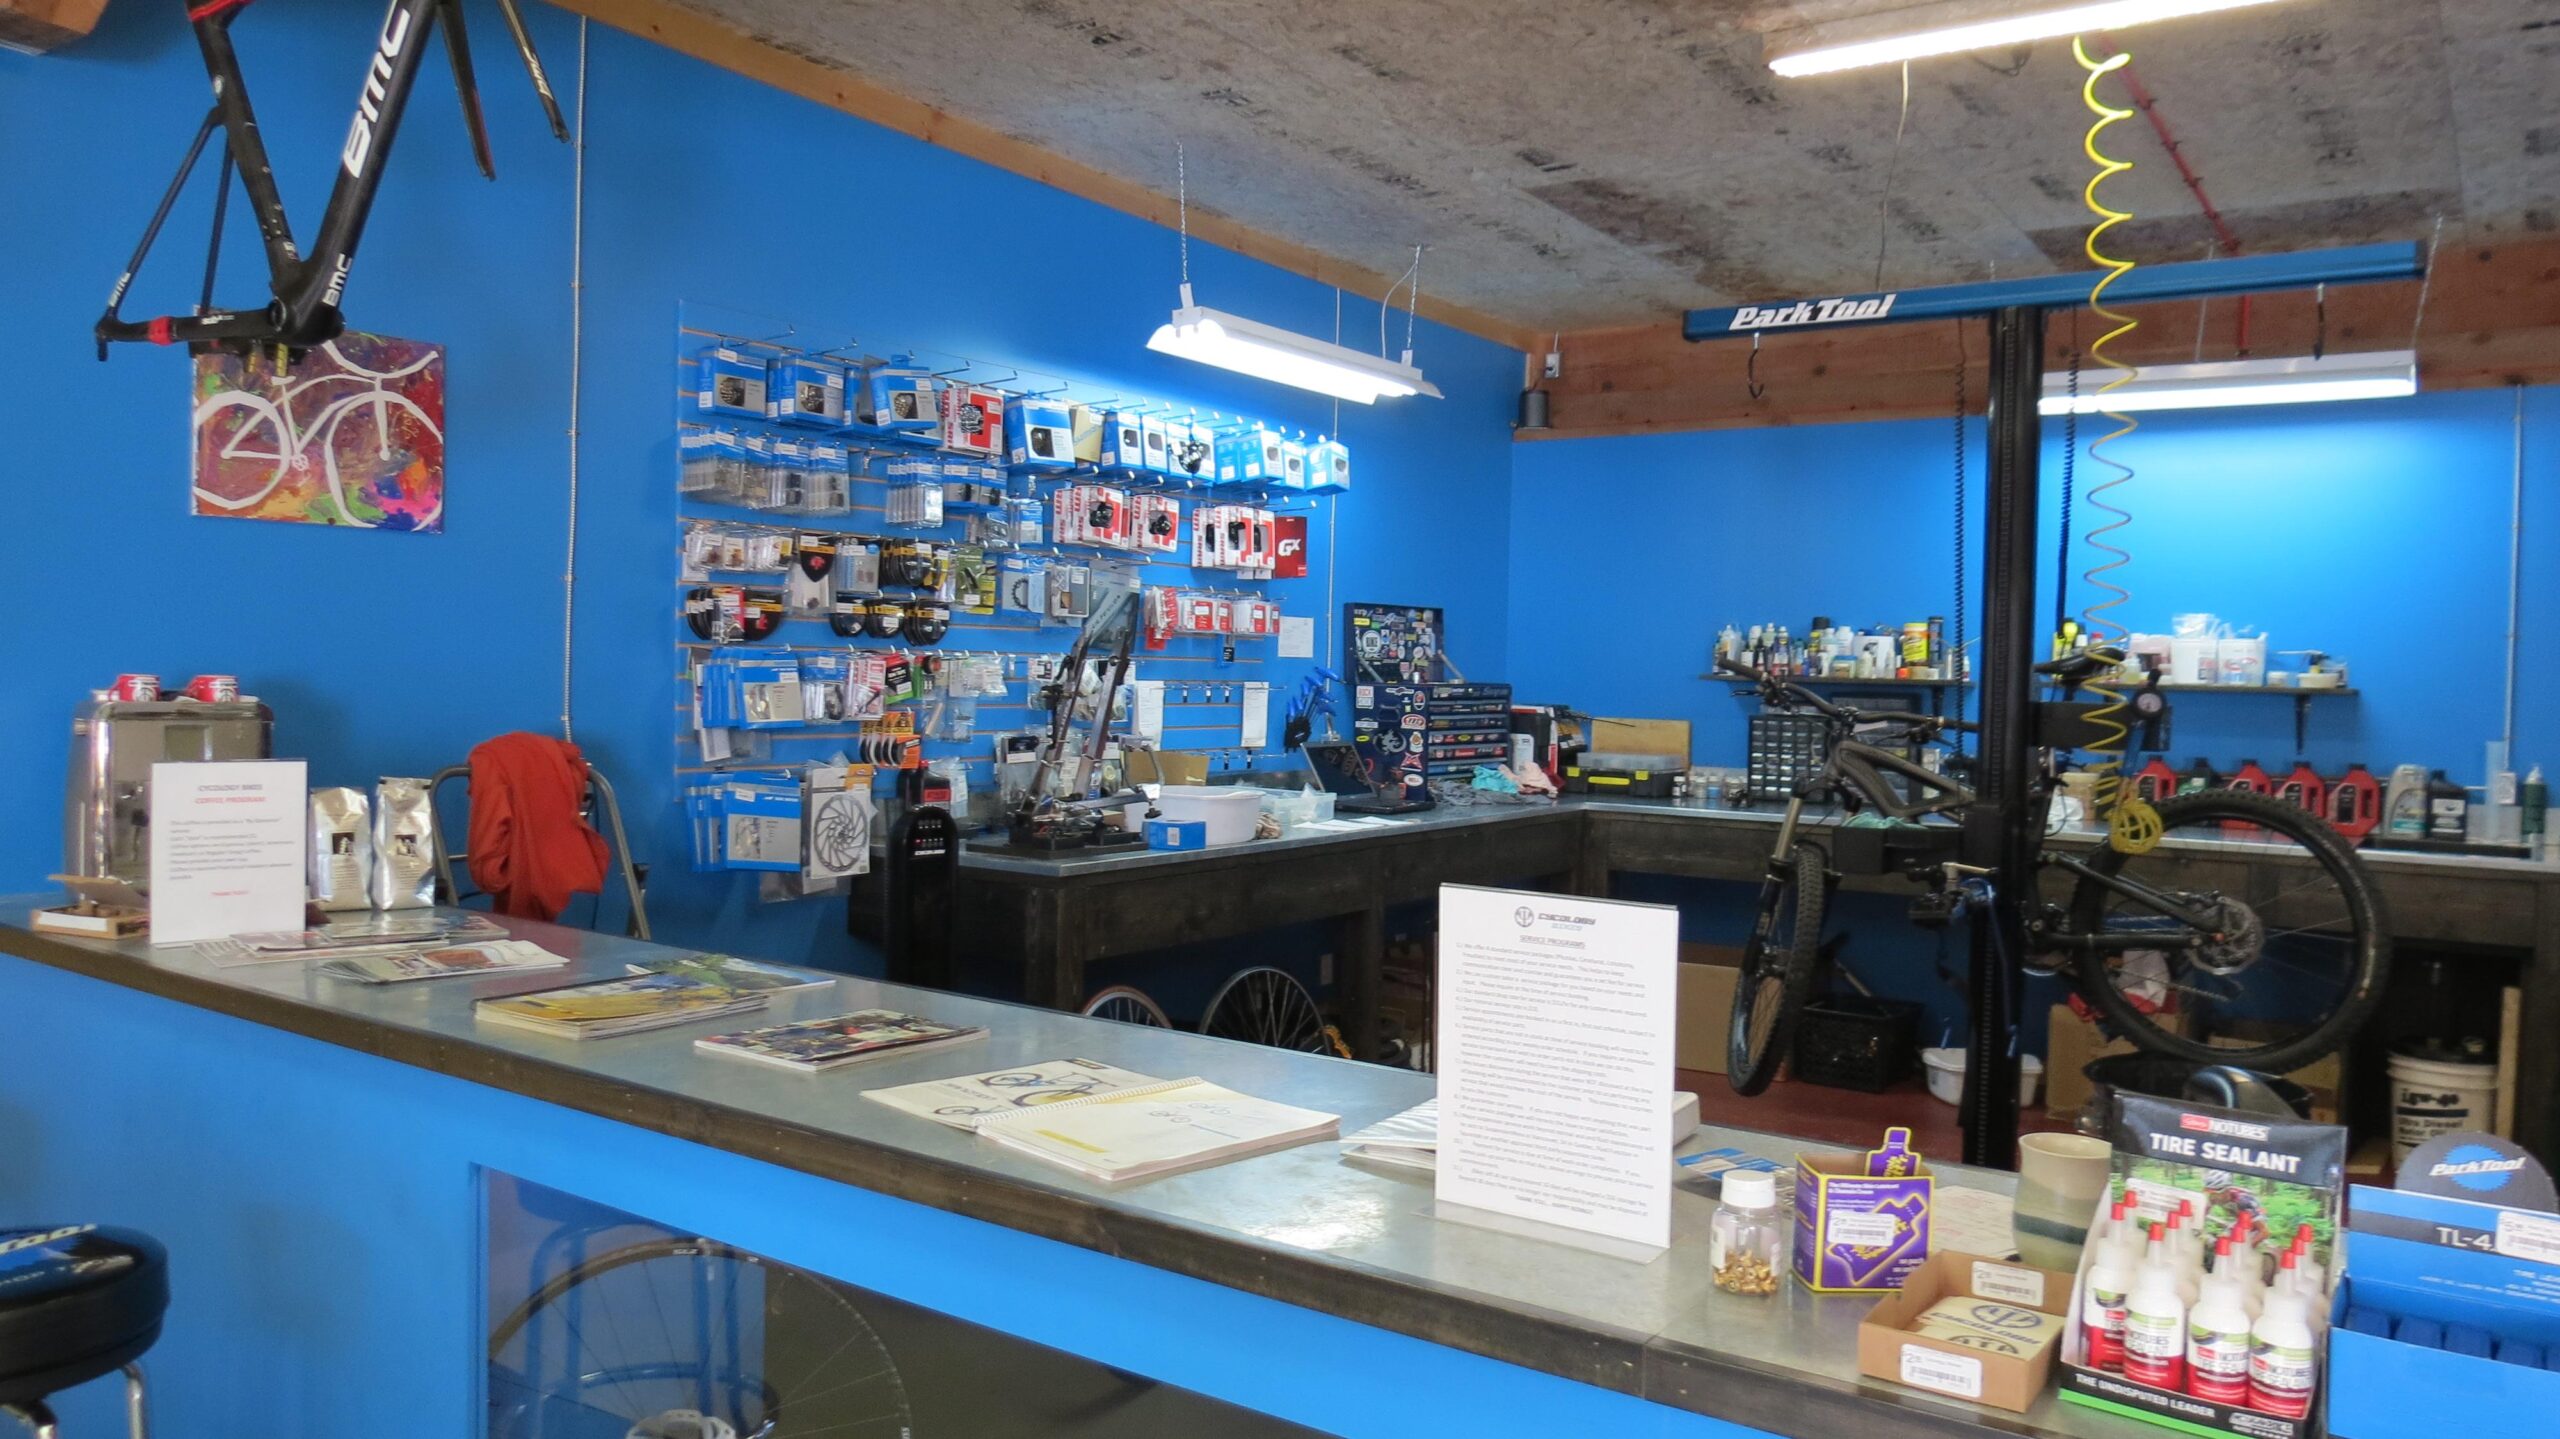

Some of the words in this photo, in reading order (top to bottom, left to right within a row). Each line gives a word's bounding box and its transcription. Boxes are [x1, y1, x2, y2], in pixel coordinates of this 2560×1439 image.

[343, 0, 411, 178] BMC
[322, 253, 352, 307] BMC
[1277, 538, 1302, 557] GX
[2150, 1132, 2196, 1156] TIRE
[2201, 1141, 2301, 1174] SEALANT
[2076, 1373, 2097, 1389] THE
[2098, 1380, 2168, 1406] UNDISPUTED
[2170, 1399, 2215, 1418] LEADER
